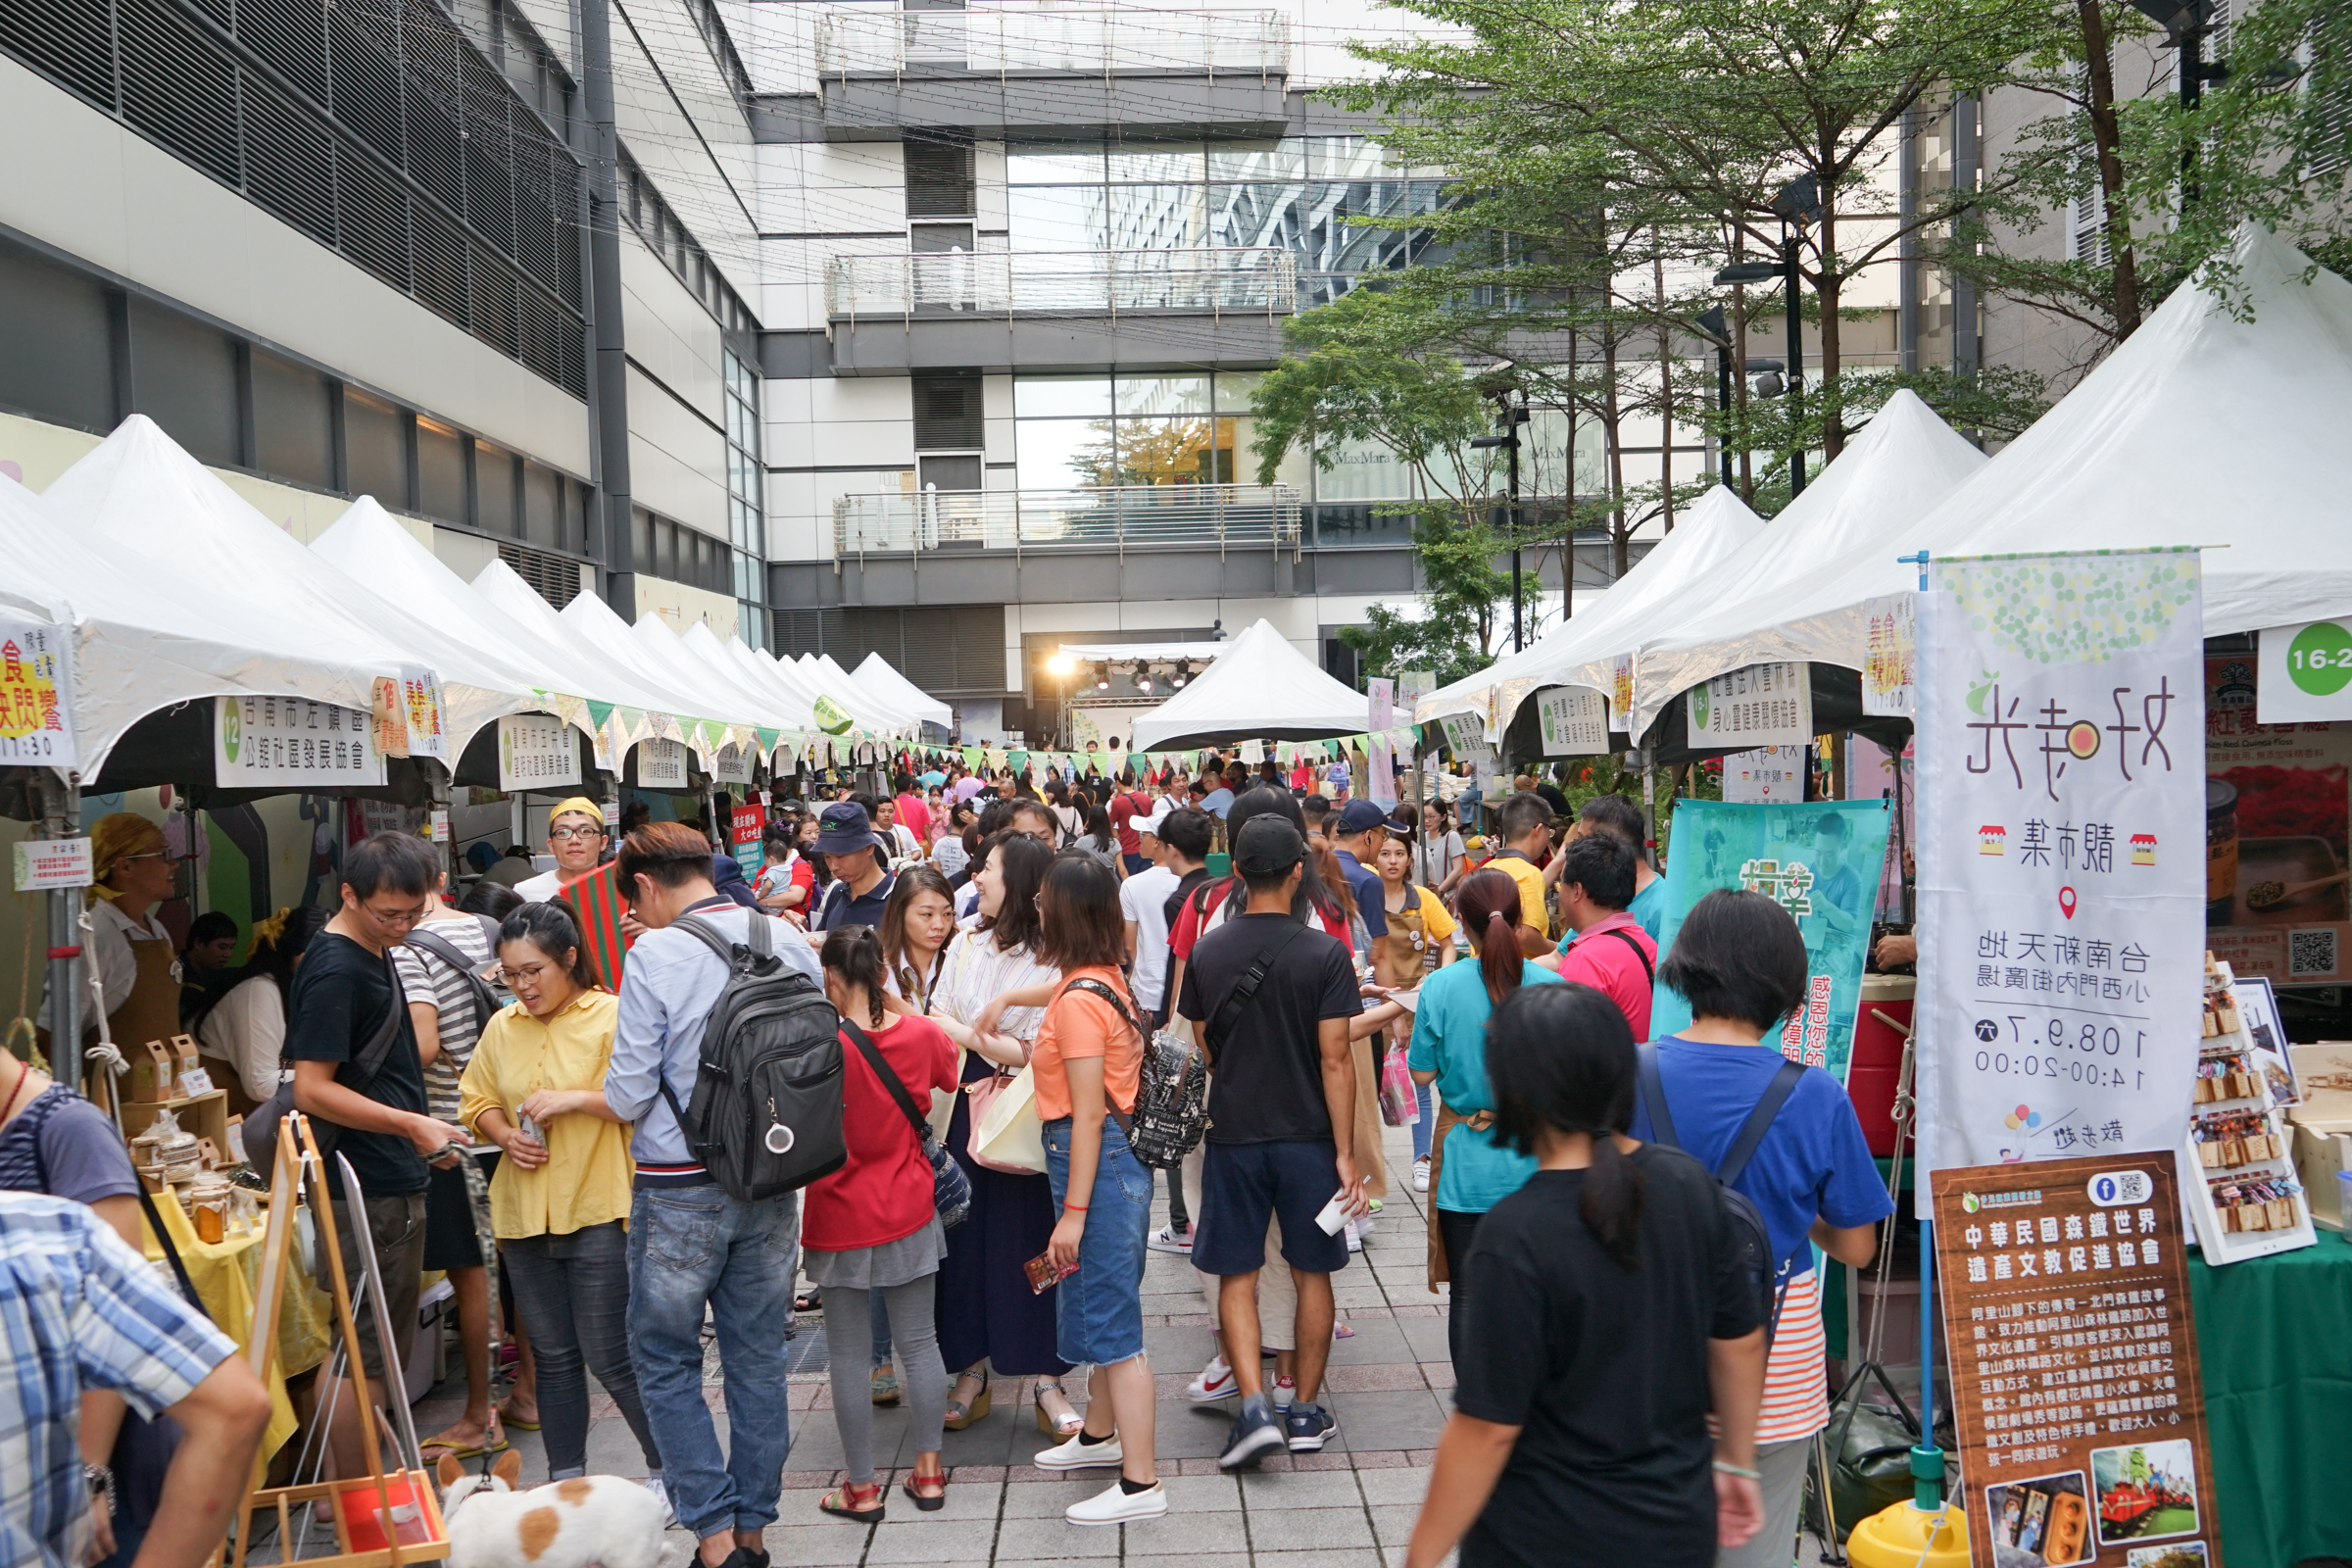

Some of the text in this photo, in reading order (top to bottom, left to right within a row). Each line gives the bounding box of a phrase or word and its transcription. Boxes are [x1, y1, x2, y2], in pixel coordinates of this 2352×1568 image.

[1335, 452, 1390, 465] MaxMara
[1531, 447, 1586, 459] MaxMra
[2293, 649, 2352, 669] 16-2
[406, 678, 425, 706] 美食
[1693, 697, 1707, 710] 16-1
[245, 696, 364, 731] 台南市左鎮區
[1713, 698, 1797, 732] 身心靈健康關懷協會
[224, 715, 239, 743] 12
[2242, 739, 2272, 748] Quinoa
[733, 813, 756, 828] 現在開始
[1805, 976, 1831, 1067] 感恩您的
[1160, 1232, 1169, 1243] N
[1965, 1208, 2156, 1250] 中華民國森鐵世界
[1967, 1239, 2159, 1282] 遺產文教促進協會
